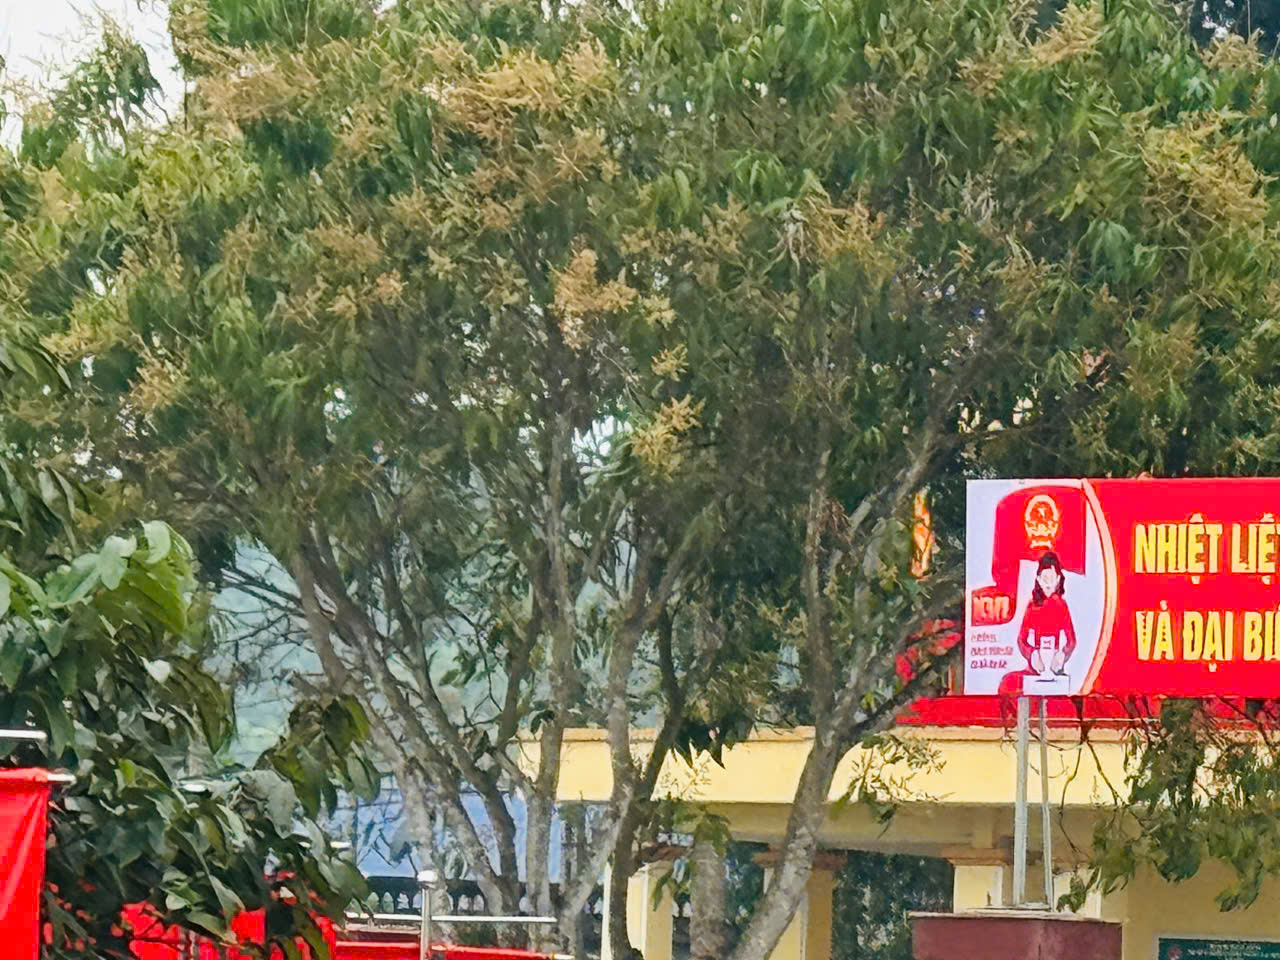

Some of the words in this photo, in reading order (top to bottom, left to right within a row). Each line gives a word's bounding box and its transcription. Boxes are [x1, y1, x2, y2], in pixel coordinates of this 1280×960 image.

[1134, 512, 1223, 585] NHIỆT
[1135, 599, 1175, 661] VÀ
[1182, 610, 1234, 673] ĐẠI
